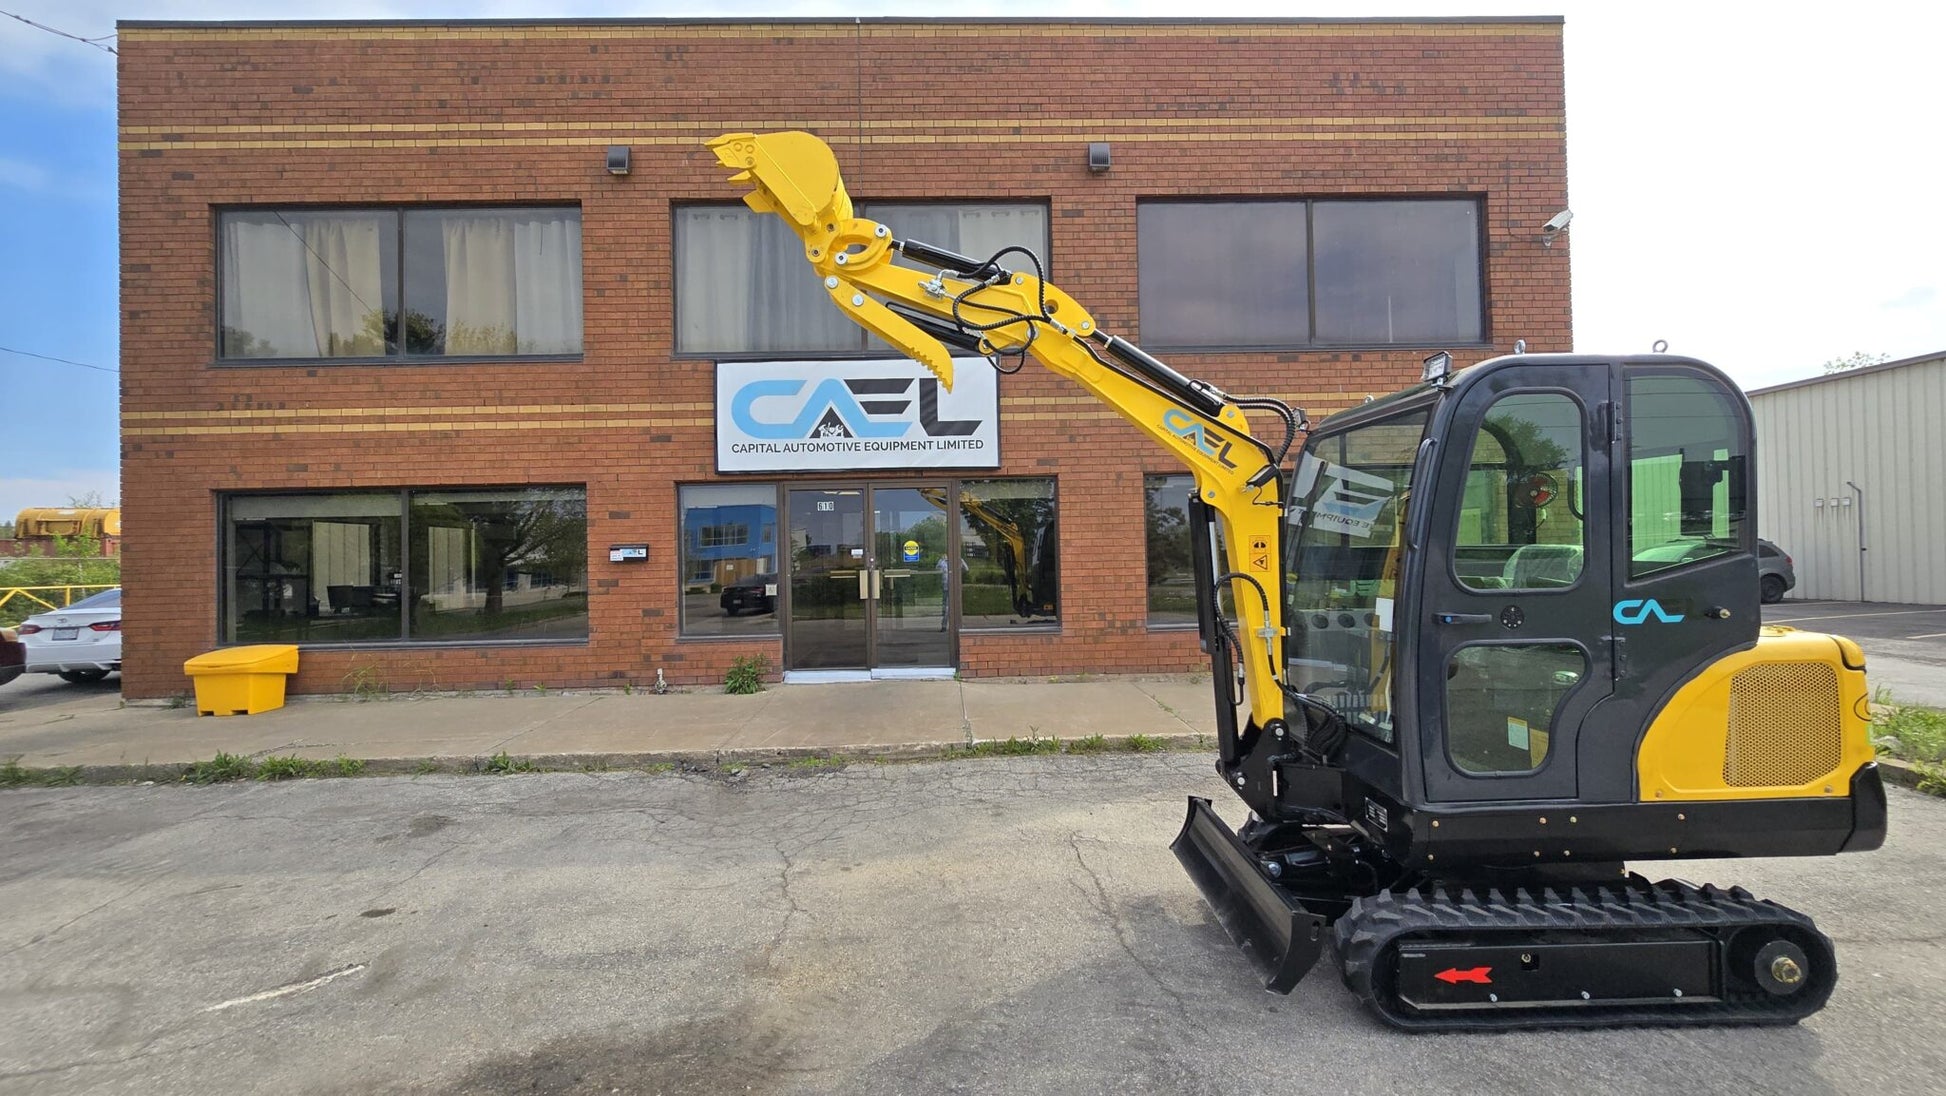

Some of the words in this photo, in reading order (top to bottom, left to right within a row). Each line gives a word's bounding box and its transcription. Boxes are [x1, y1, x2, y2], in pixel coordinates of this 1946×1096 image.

[731, 377, 983, 439] CAEL
[731, 443, 781, 453] CAPITAL
[783, 442, 861, 453] AUTOMOTIVE
[864, 440, 934, 451] EQUIPMENT
[937, 439, 984, 450] LIMITED
[1163, 409, 1238, 469] CAEL
[818, 502, 834, 511] 610
